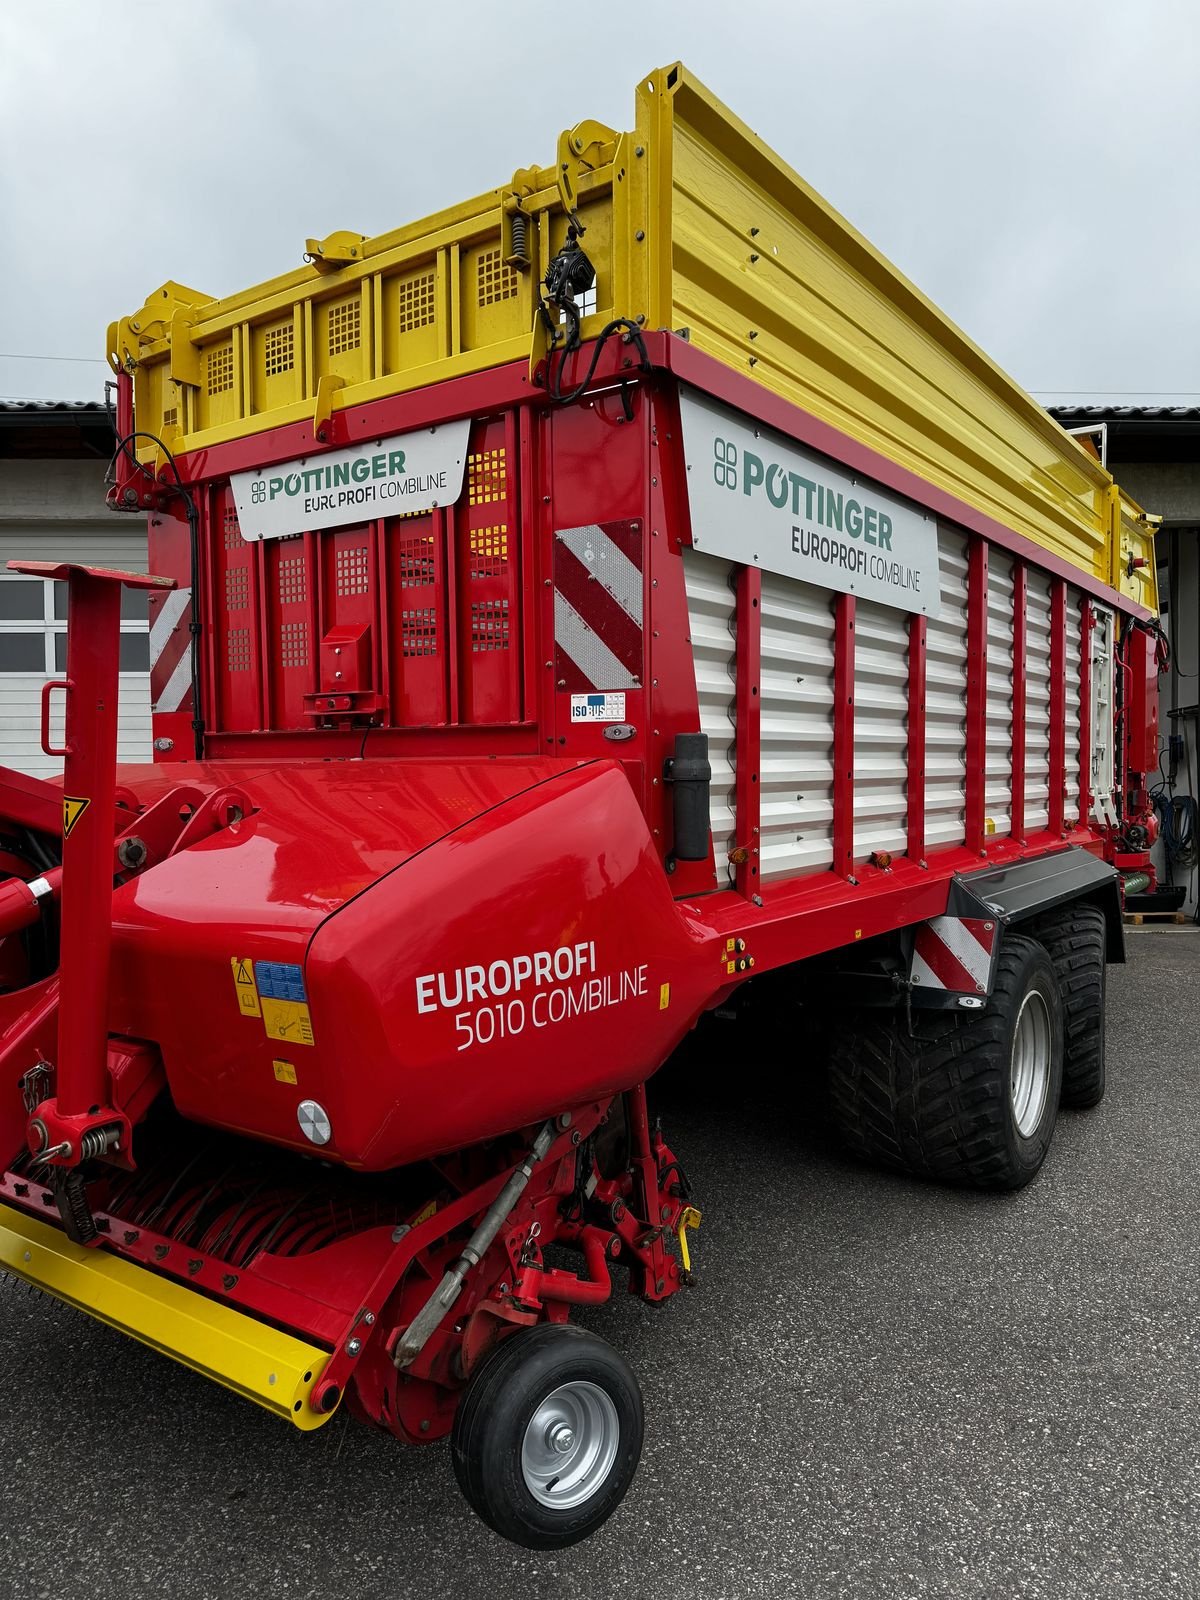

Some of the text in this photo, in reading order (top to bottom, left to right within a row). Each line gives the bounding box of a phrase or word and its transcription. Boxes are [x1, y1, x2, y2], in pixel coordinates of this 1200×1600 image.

[269, 450, 406, 500] PÖTTINGER
[379, 471, 447, 499] COMBILINE
[743, 450, 893, 552] PÖTTINGER
[791, 525, 921, 592] EUROPROFI COMBILINE
[415, 941, 596, 1014] EUROPROFI
[455, 964, 648, 1051] 5010 COMBILINE
